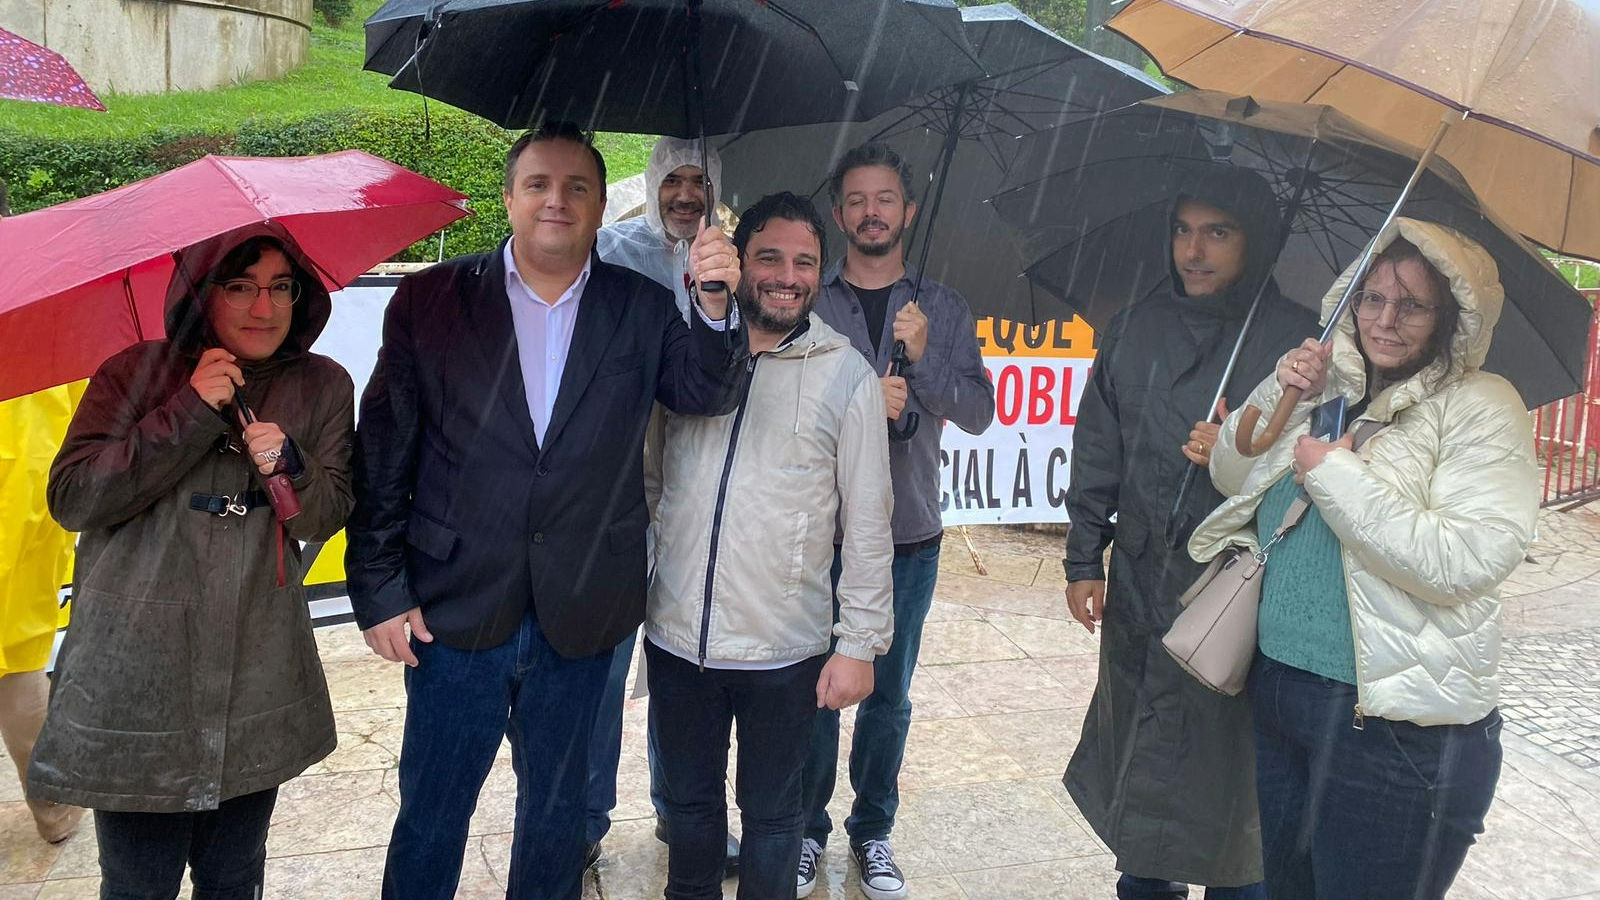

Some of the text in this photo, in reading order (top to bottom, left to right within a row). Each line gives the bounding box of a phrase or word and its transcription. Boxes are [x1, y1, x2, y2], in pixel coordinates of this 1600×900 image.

[985, 364, 1092, 426] OBL
[1012, 432, 1033, 508] À
[1046, 447, 1074, 508] C
